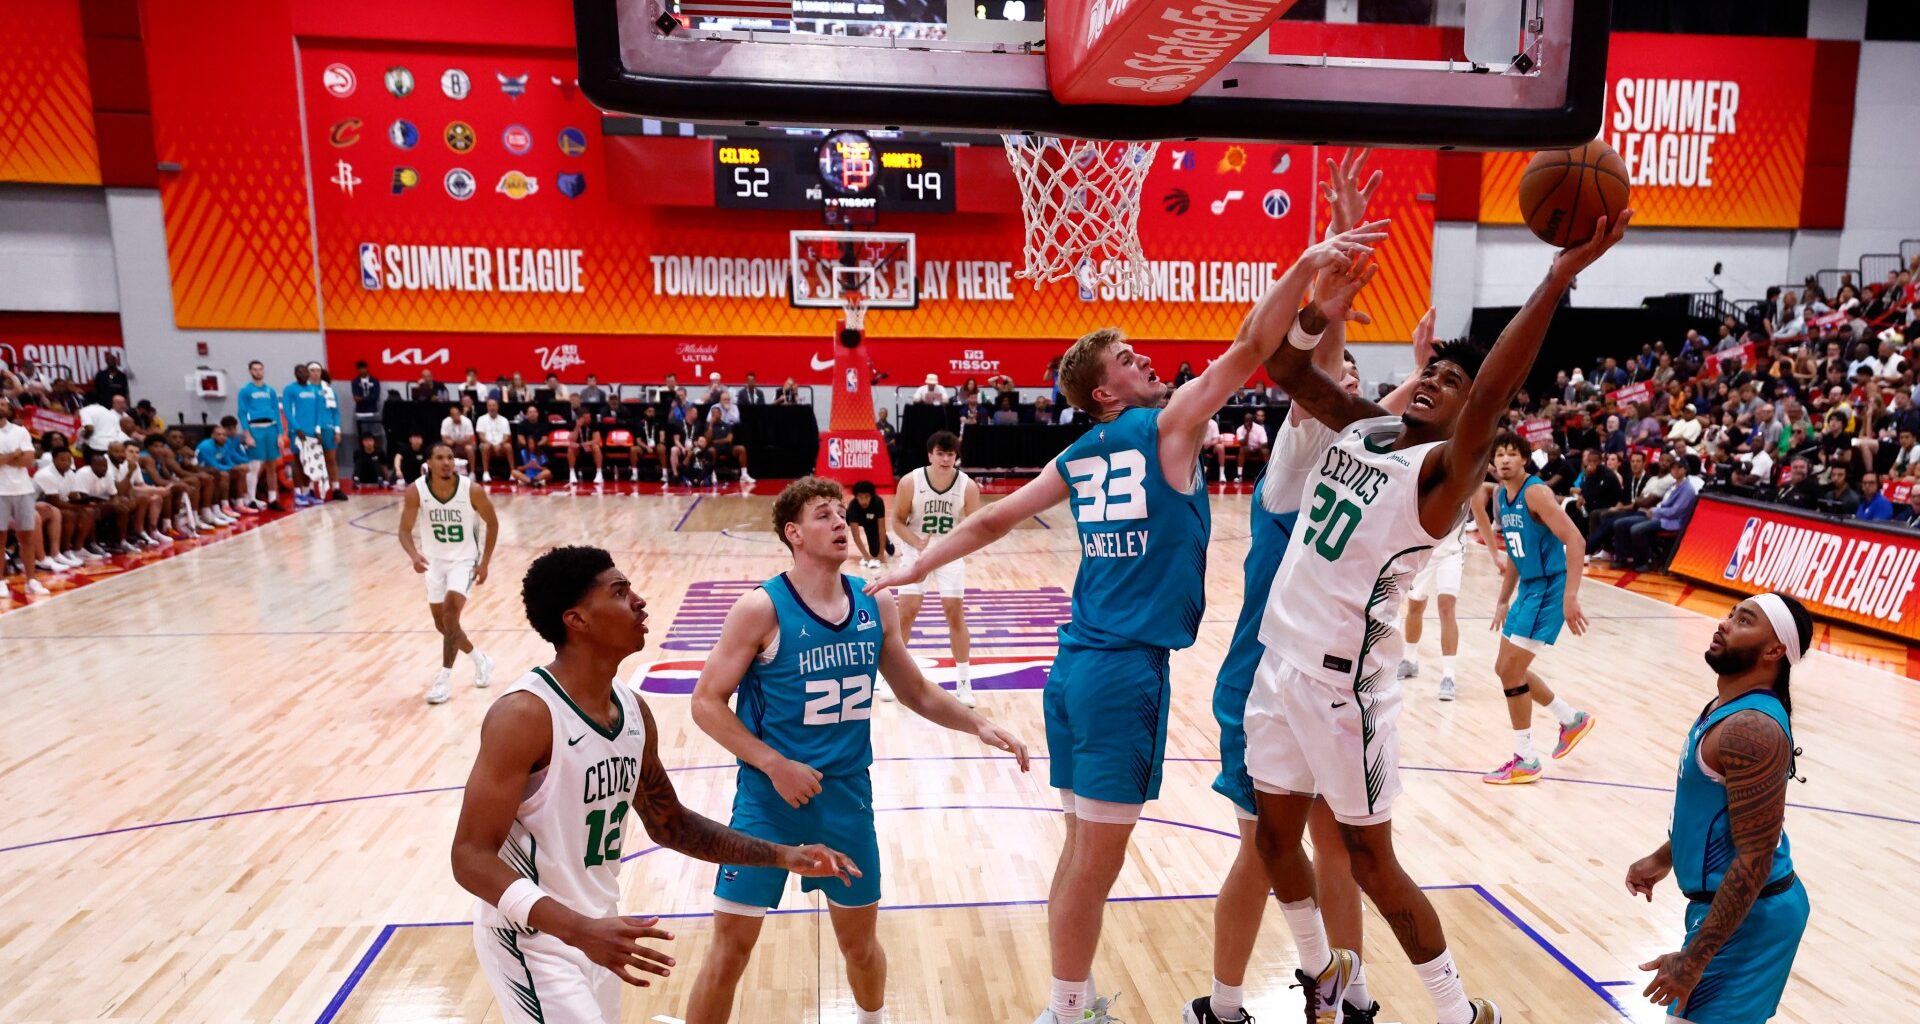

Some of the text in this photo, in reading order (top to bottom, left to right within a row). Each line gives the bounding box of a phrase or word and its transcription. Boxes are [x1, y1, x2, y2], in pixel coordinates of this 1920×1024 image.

[1613, 77, 1740, 134] SUMMER
[719, 148, 760, 165] CELTICS
[734, 167, 769, 198] 52
[906, 172, 941, 200] 49
[384, 244, 585, 293] SUMMER LEAGUE
[650, 255, 811, 298] TOMORROWS
[957, 261, 1014, 300] HERE
[682, 354, 715, 362] ULTRA
[949, 360, 1000, 370] TISSOT
[843, 438, 879, 454] SUMMER
[843, 453, 873, 468] LEAGUE
[1065, 448, 1149, 523] 33
[1320, 446, 1389, 506] CELTICS
[429, 508, 462, 522] CELTICS
[924, 500, 953, 515] CELTICS
[431, 524, 464, 543] 29
[921, 515, 954, 535] 28
[1741, 520, 1920, 623] SUMMER LEAGUE
[798, 641, 876, 675] HORNETS
[803, 673, 872, 726] 22
[584, 756, 637, 805] CELTICS
[583, 800, 629, 870] 12
